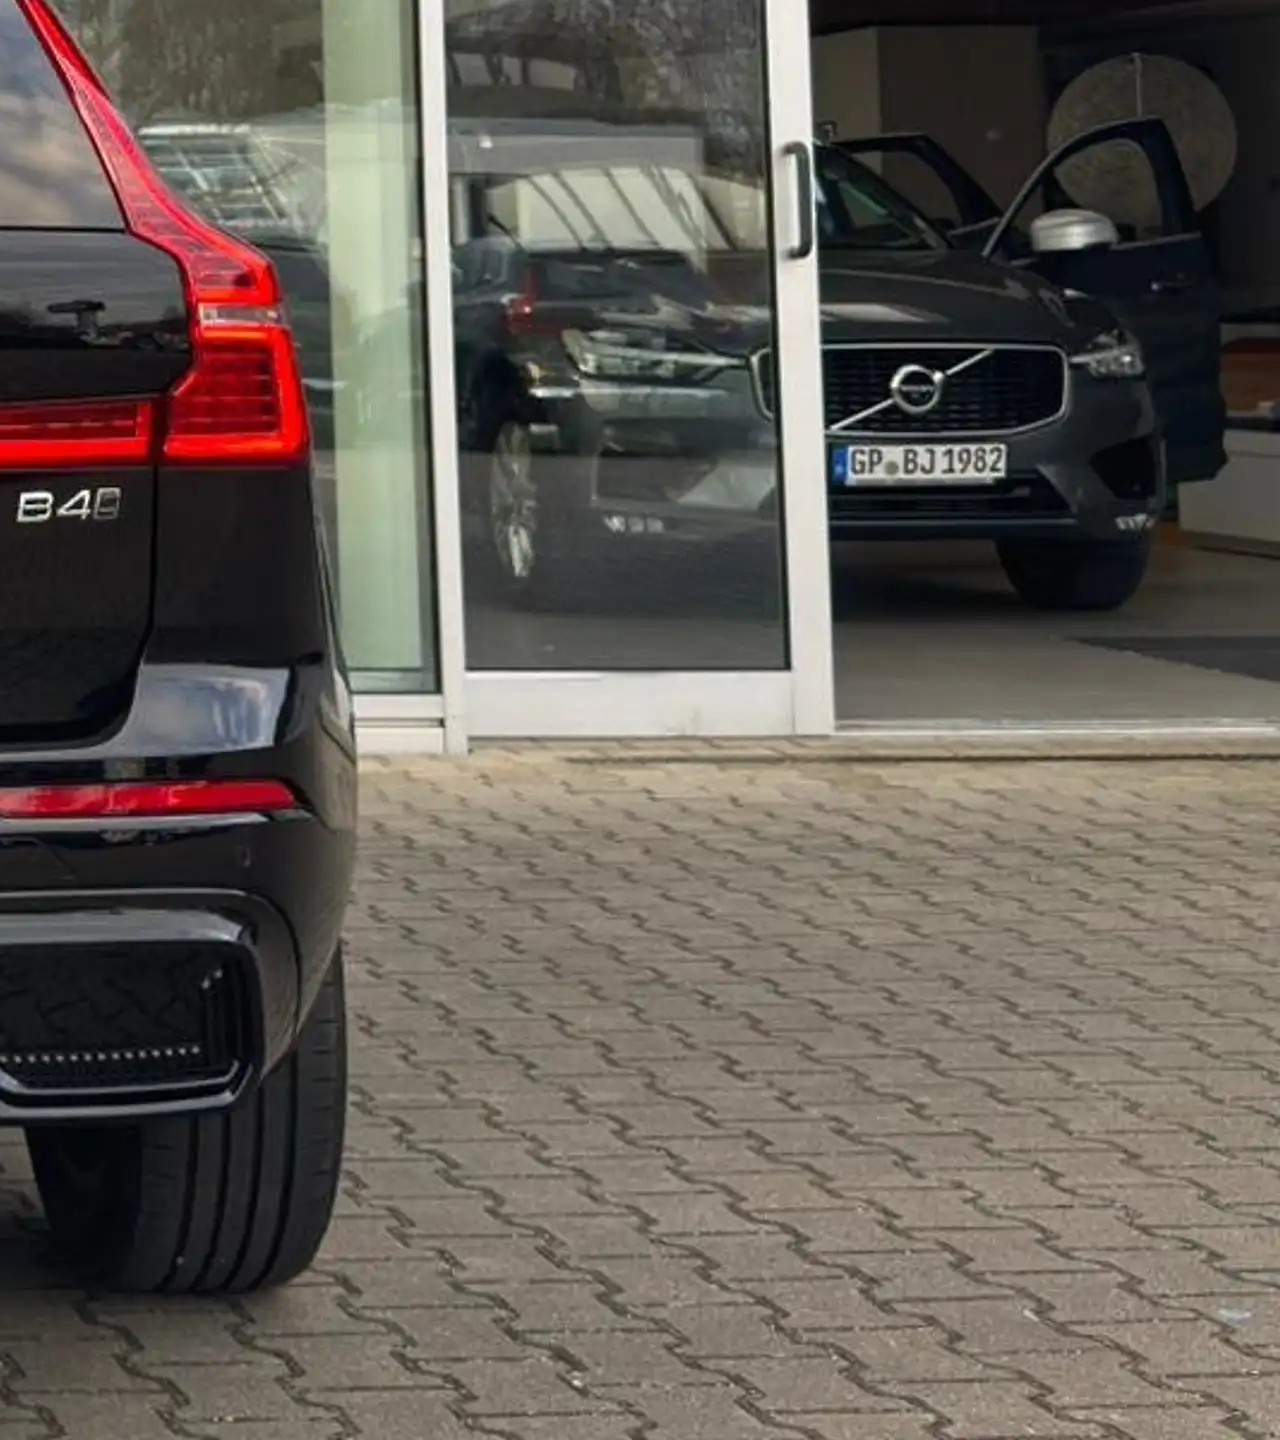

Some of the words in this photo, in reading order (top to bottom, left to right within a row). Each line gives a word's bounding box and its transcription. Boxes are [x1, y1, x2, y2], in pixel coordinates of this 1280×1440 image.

[851, 448, 883, 475] GP
[903, 448, 936, 474] BJ
[941, 446, 1003, 474] 1982
